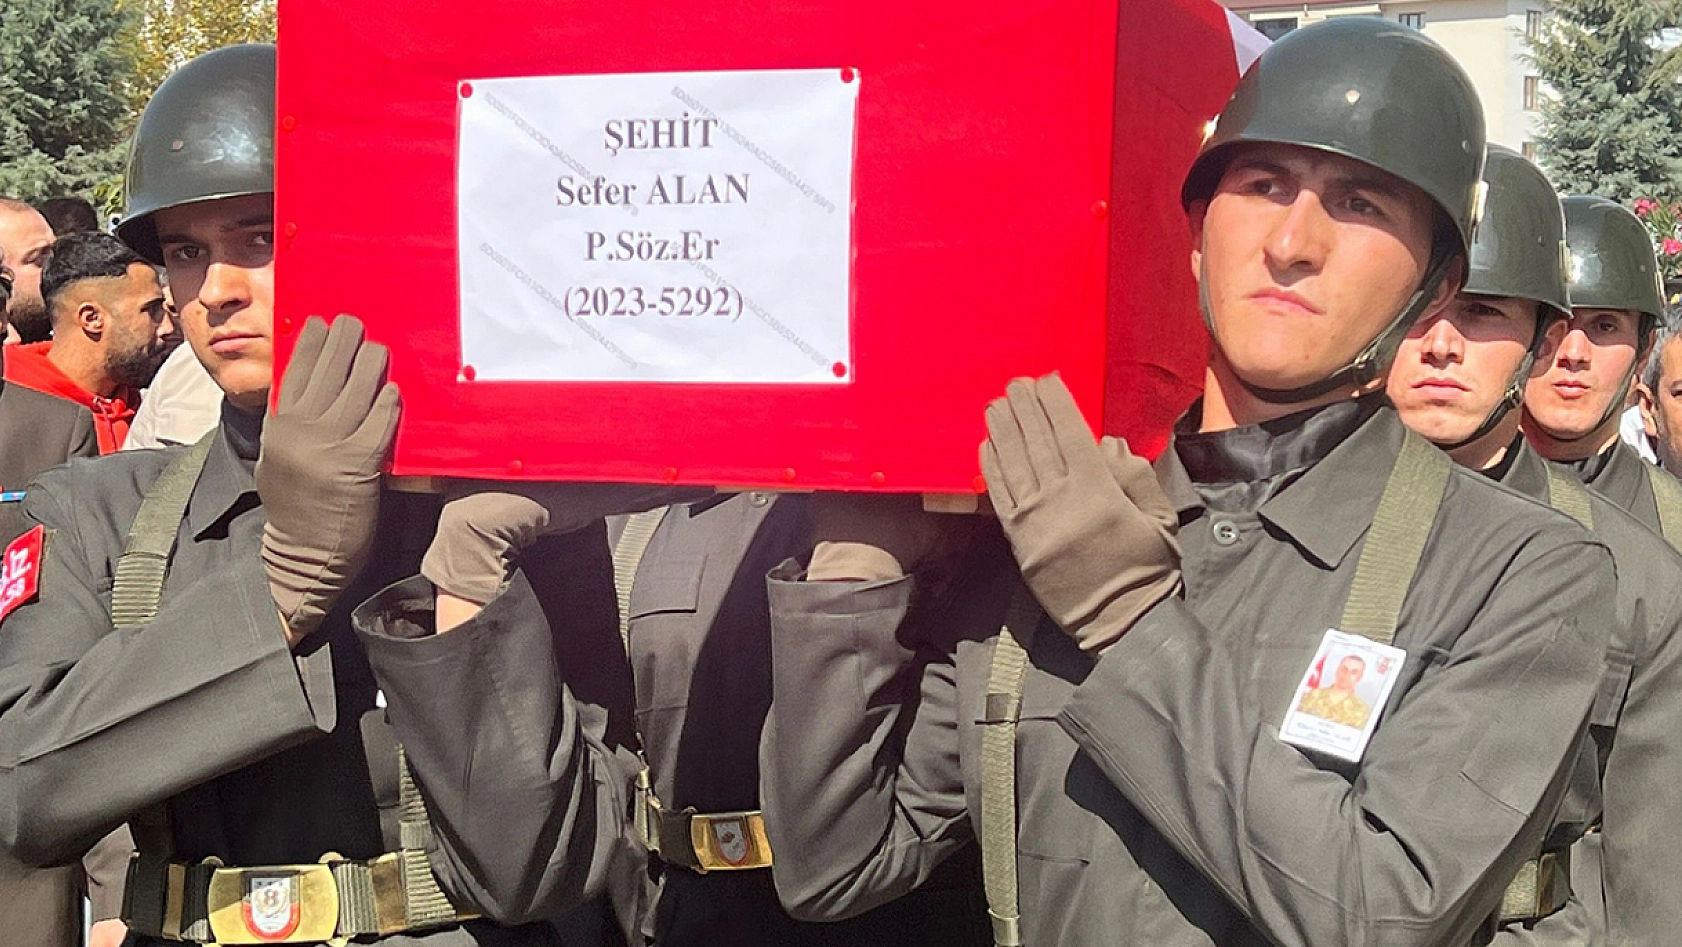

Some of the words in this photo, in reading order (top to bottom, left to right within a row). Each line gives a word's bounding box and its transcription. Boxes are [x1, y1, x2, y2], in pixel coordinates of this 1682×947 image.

[604, 111, 719, 157] ŞEHİT
[556, 175, 638, 207] Sefer
[646, 173, 751, 205] ALAN
[584, 230, 721, 262] P.Söz.Er
[563, 286, 745, 323] (2023-5292)
